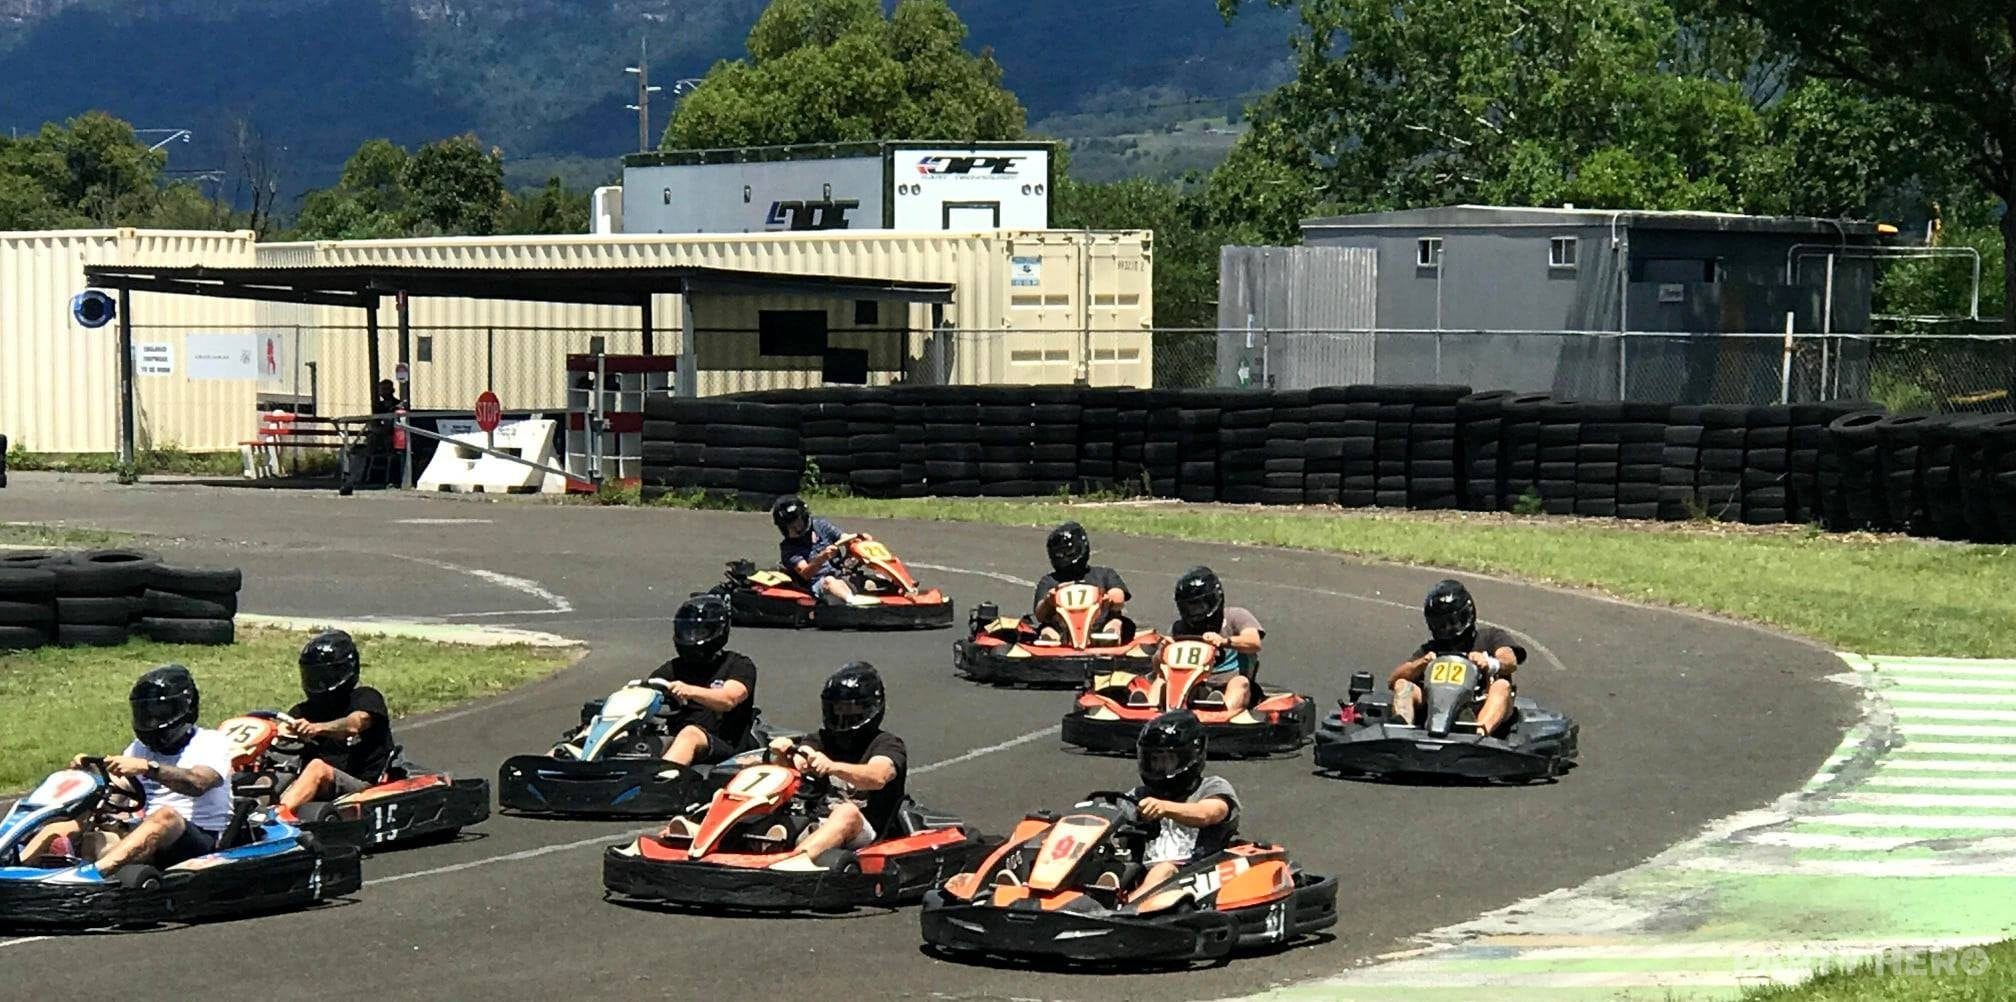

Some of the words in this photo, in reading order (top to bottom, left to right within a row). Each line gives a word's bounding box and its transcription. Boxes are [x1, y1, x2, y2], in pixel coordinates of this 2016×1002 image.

[476, 401, 499, 422] STOP
[1066, 589, 1088, 606] 17
[1175, 646, 1202, 665] 18
[1433, 664, 1463, 682] 22
[225, 724, 258, 743] 15
[374, 804, 398, 842] 15
